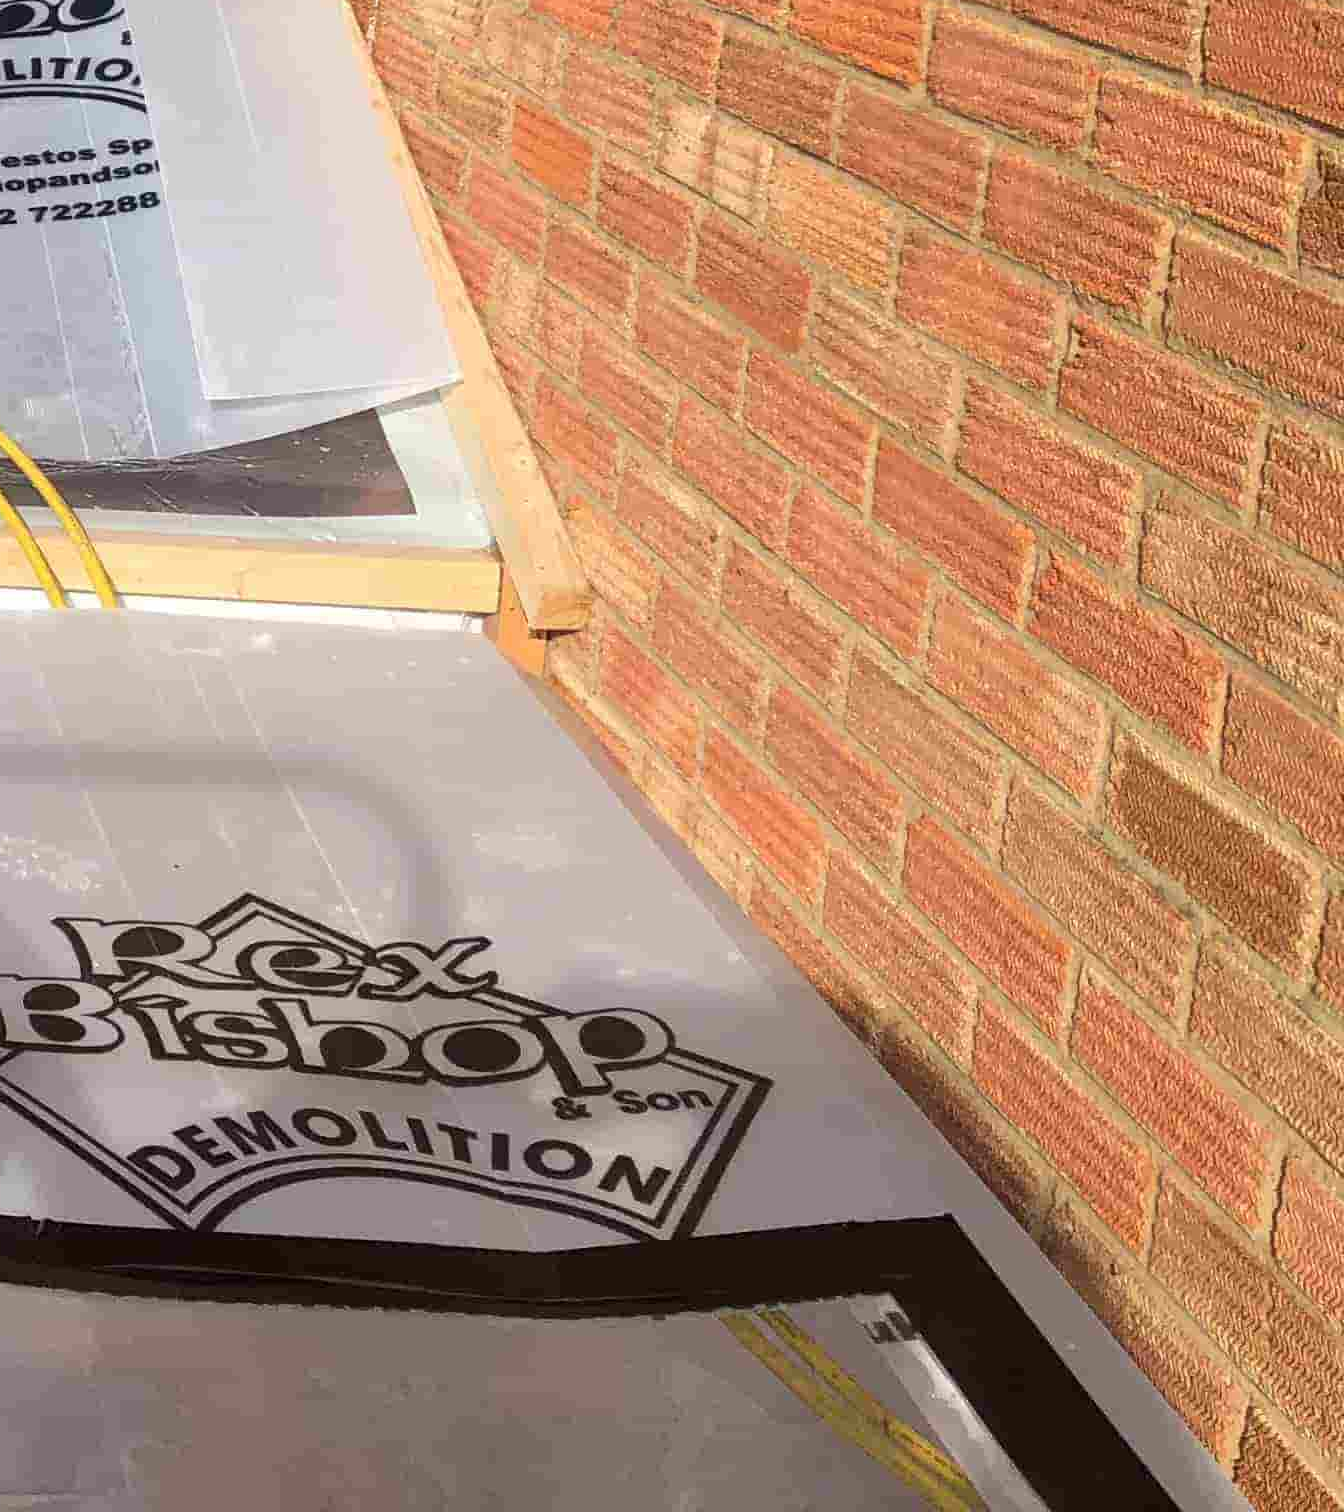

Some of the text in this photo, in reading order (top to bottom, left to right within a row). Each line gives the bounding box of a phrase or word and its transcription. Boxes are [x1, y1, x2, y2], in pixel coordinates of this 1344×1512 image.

[28, 191, 160, 224] 722288
[51, 917, 498, 1001] Rex
[553, 1087, 714, 1122] & Son
[126, 1107, 675, 1209] DEMOLITION
